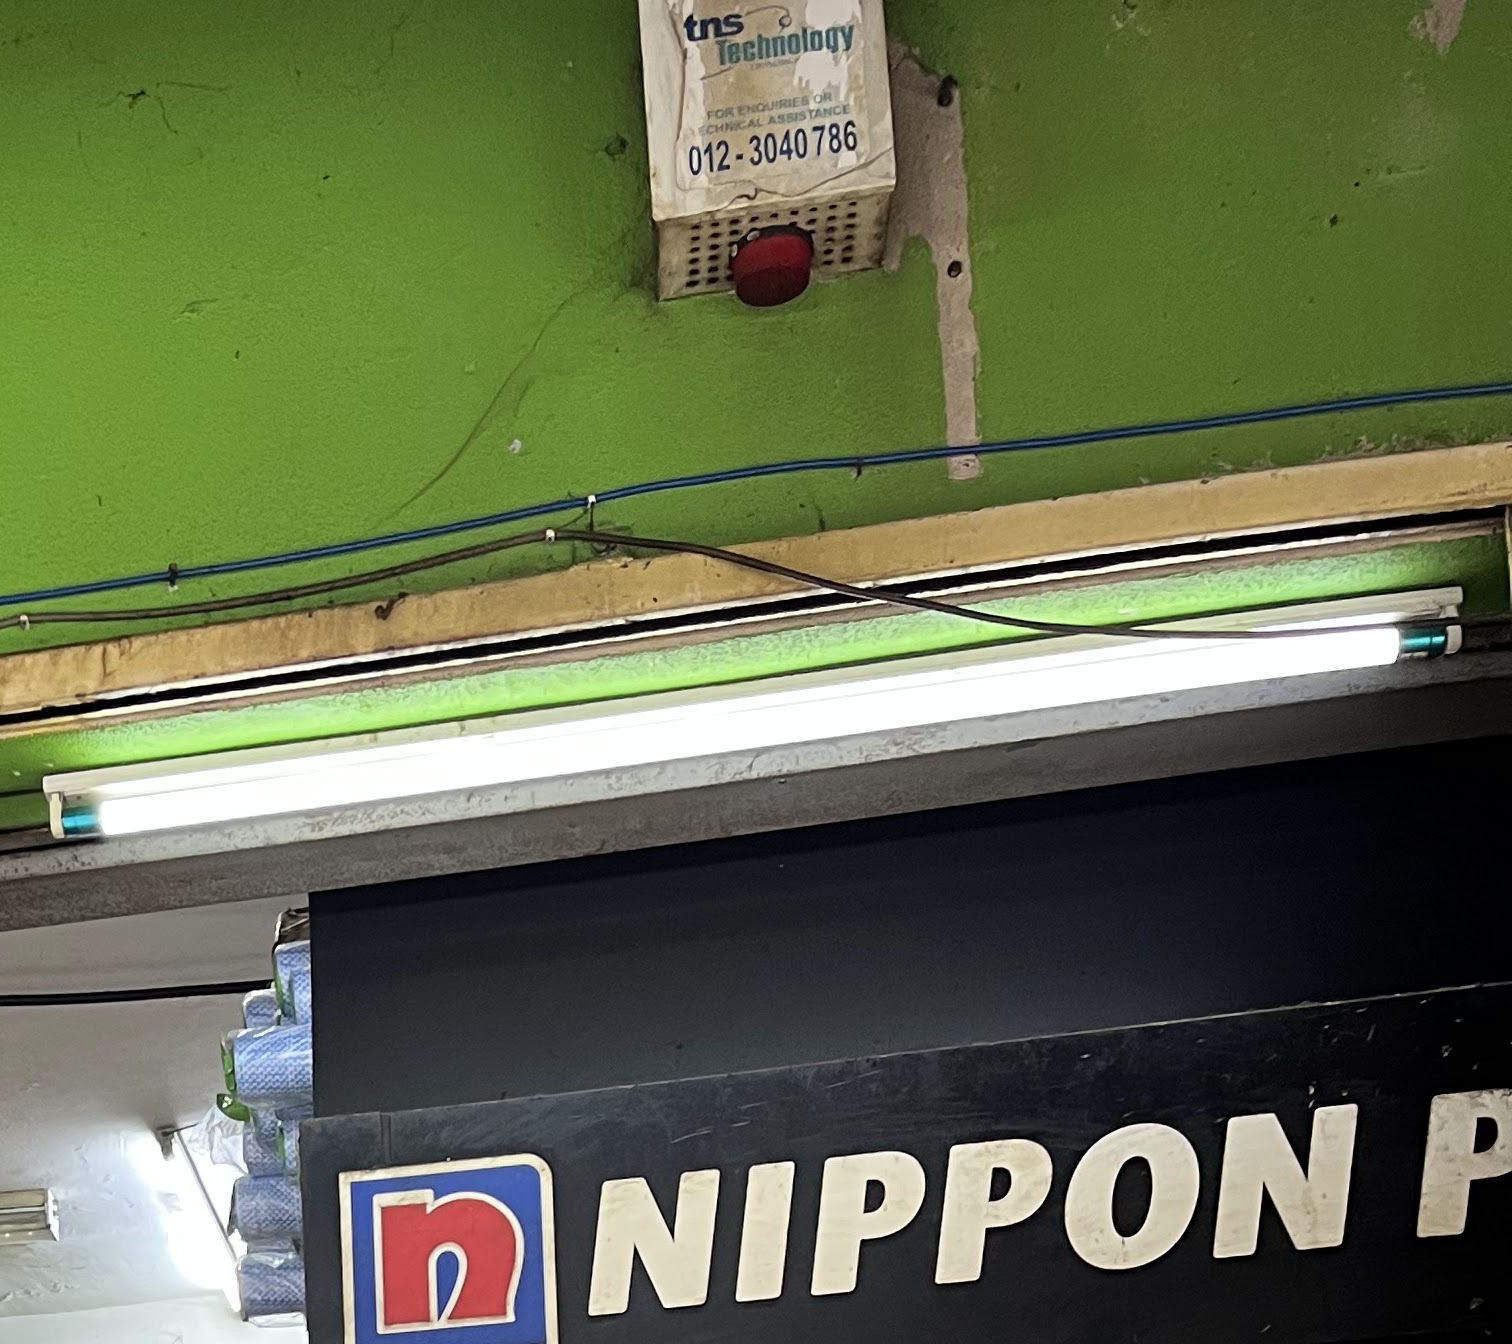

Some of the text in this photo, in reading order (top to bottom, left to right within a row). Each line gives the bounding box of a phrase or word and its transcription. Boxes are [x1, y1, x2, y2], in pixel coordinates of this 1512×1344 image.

[684, 13, 744, 42] tns
[717, 24, 855, 66] Technology
[698, 103, 851, 136] ECHNICAL ASSISTANCE
[707, 92, 833, 121] FOR ENQUIRIES OR
[589, 1103, 1359, 1317] NIPPON
